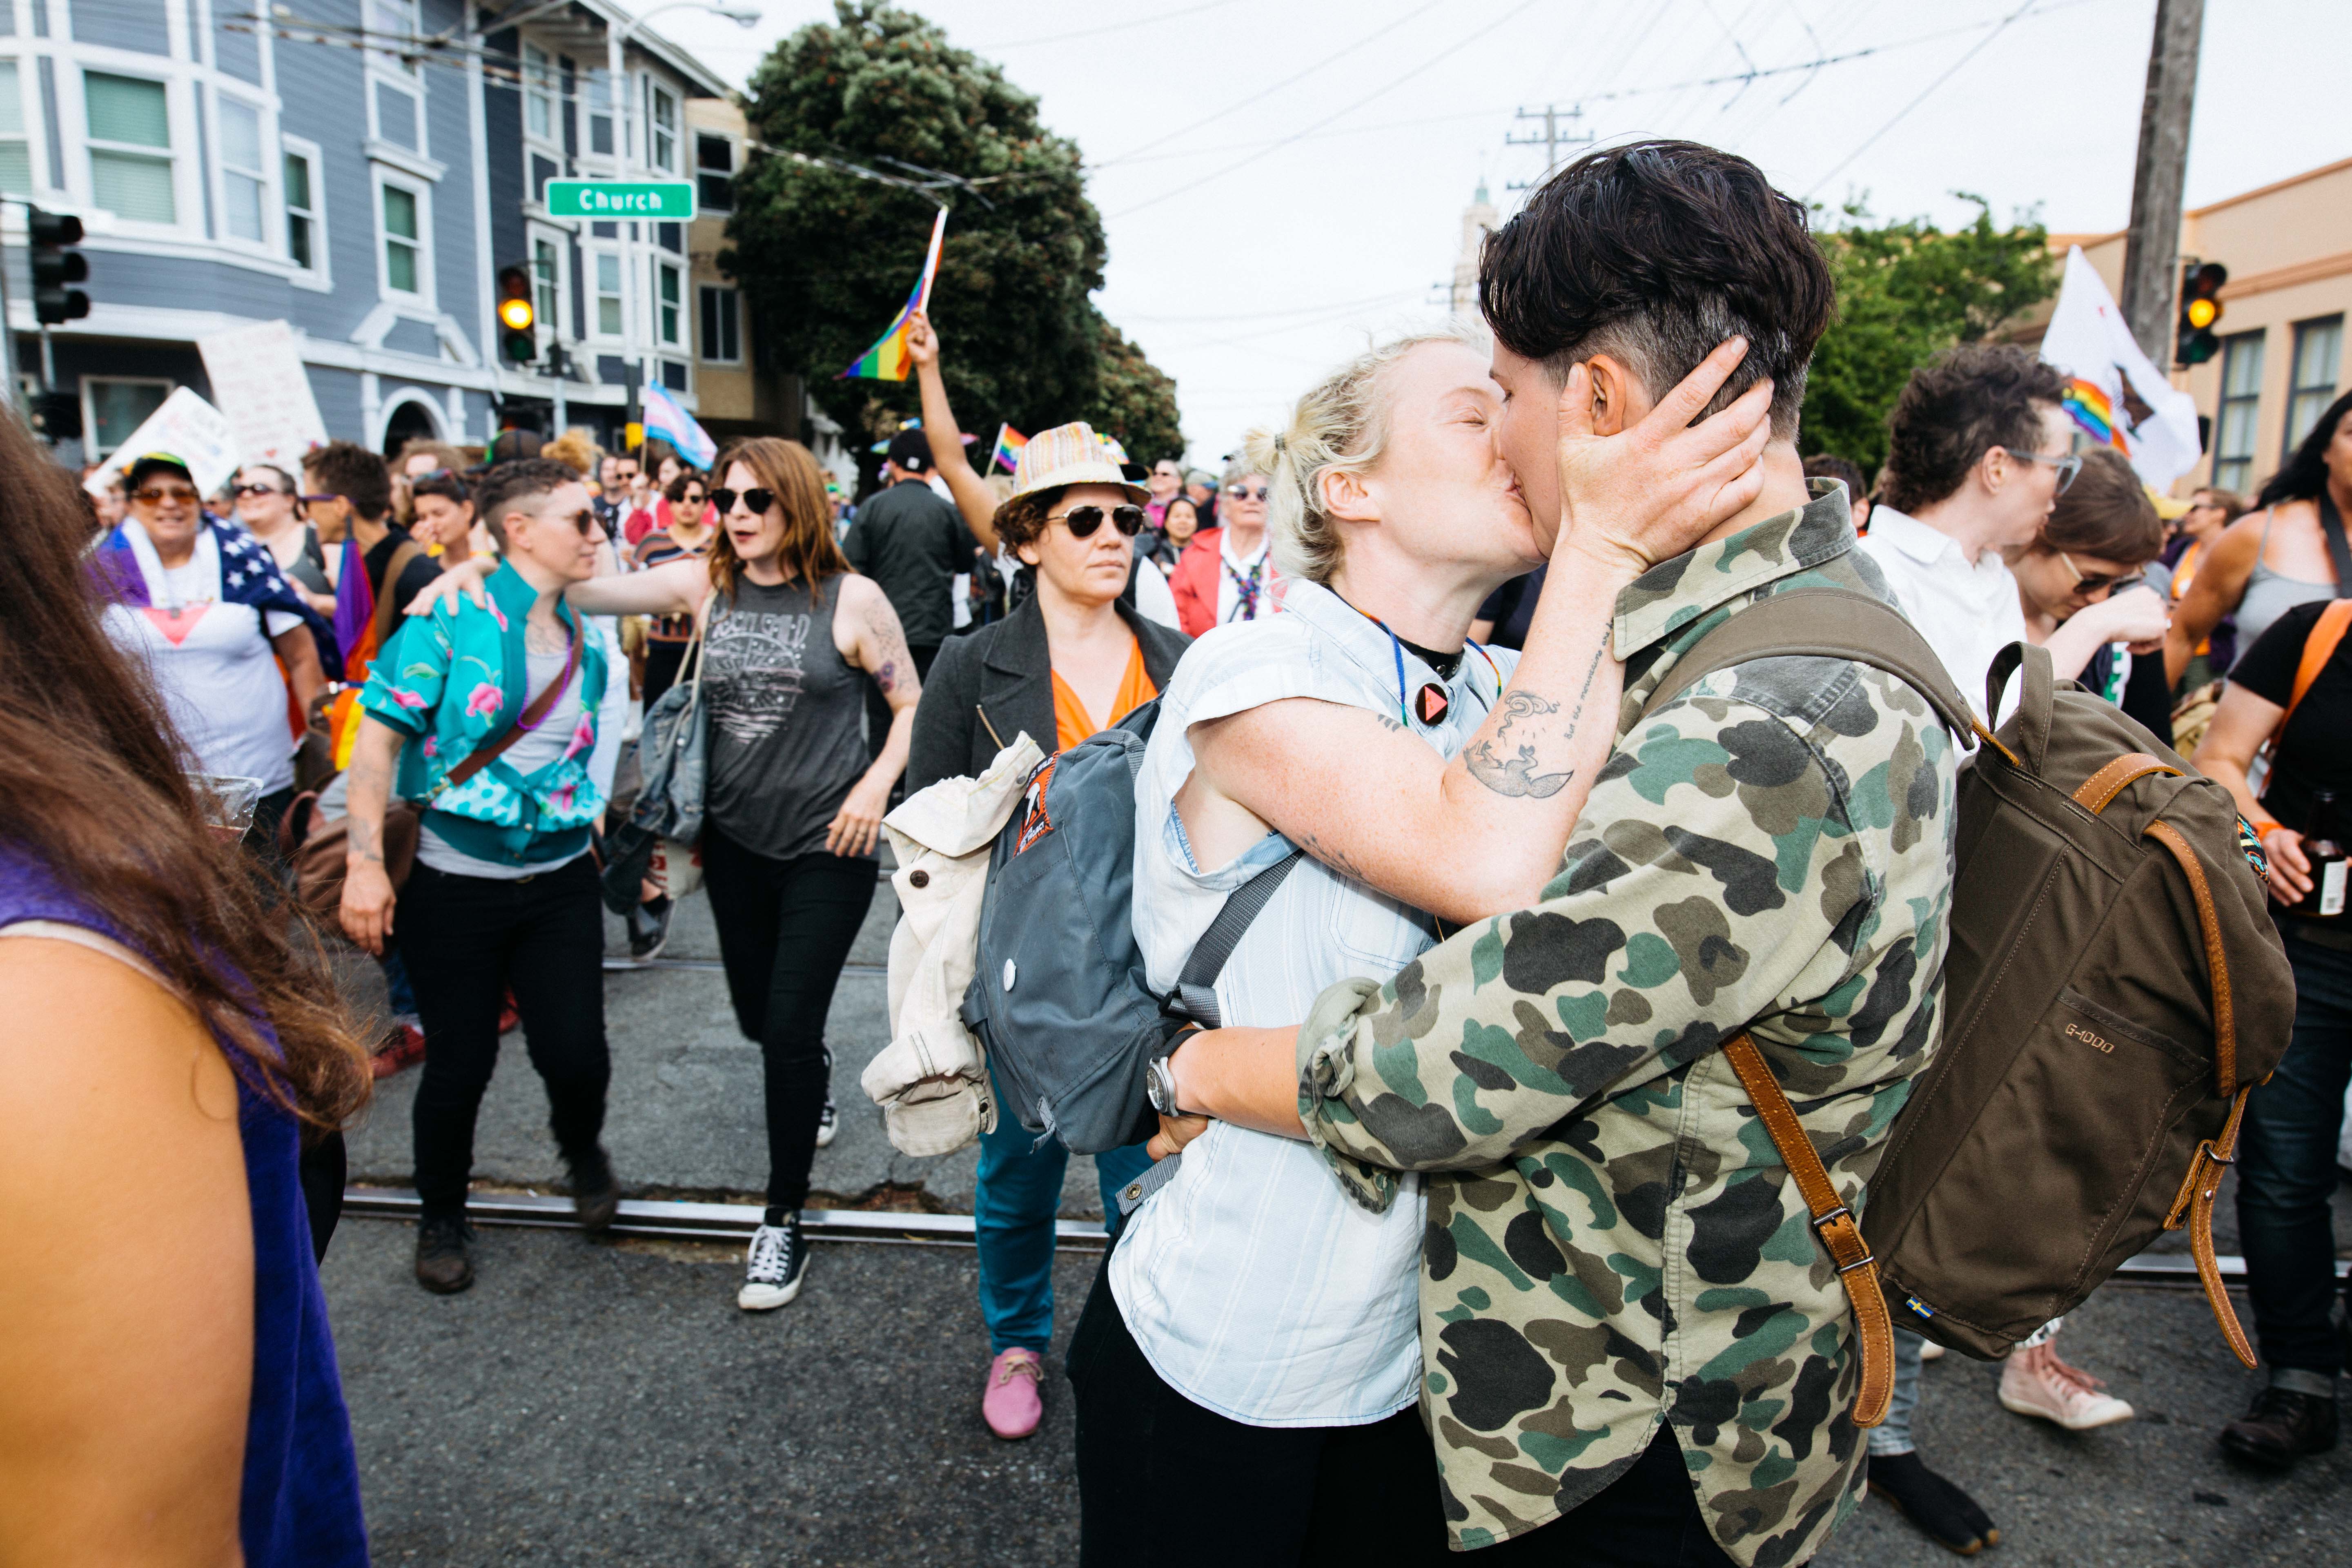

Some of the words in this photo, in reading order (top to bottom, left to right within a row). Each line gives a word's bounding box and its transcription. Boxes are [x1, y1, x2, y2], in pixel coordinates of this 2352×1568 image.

[579, 189, 662, 210] Church
[1564, 723, 1575, 739] But
[1573, 704, 1581, 720] the
[2065, 1023, 2115, 1054] G-1000
